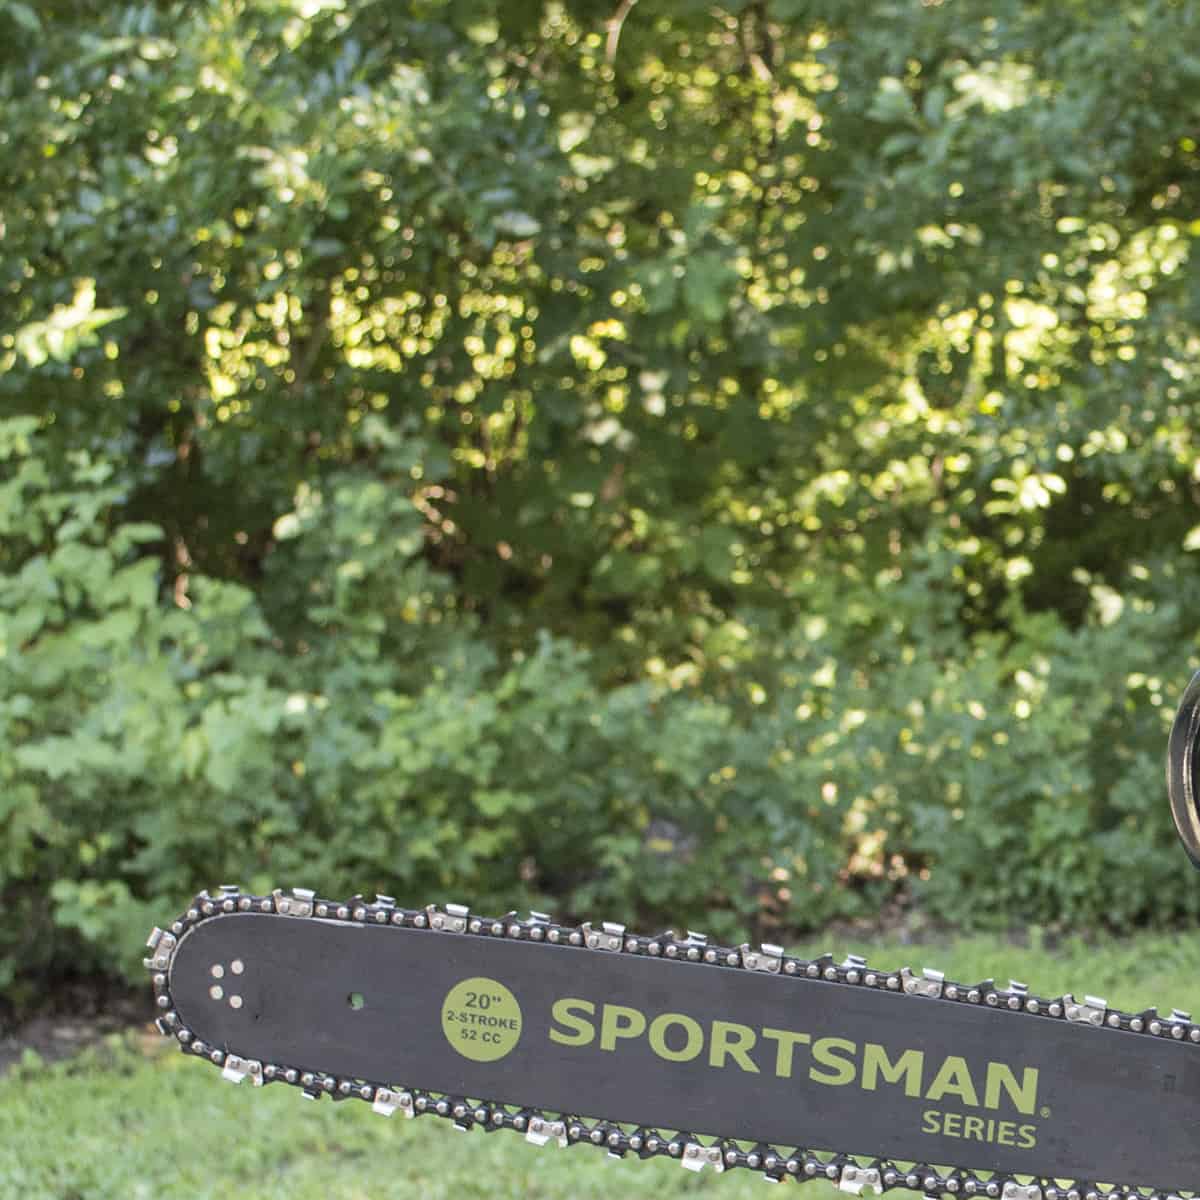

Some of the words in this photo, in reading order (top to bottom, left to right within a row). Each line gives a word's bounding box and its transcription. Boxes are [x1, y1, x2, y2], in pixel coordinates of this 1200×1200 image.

[465, 992, 502, 1010] 20"
[447, 1010, 518, 1030] 2-STROKE
[461, 1028, 477, 1041] 52
[482, 1031, 501, 1044] CC
[549, 998, 1039, 1115] SPORTSMAN
[921, 1110, 1037, 1148] SERIES
